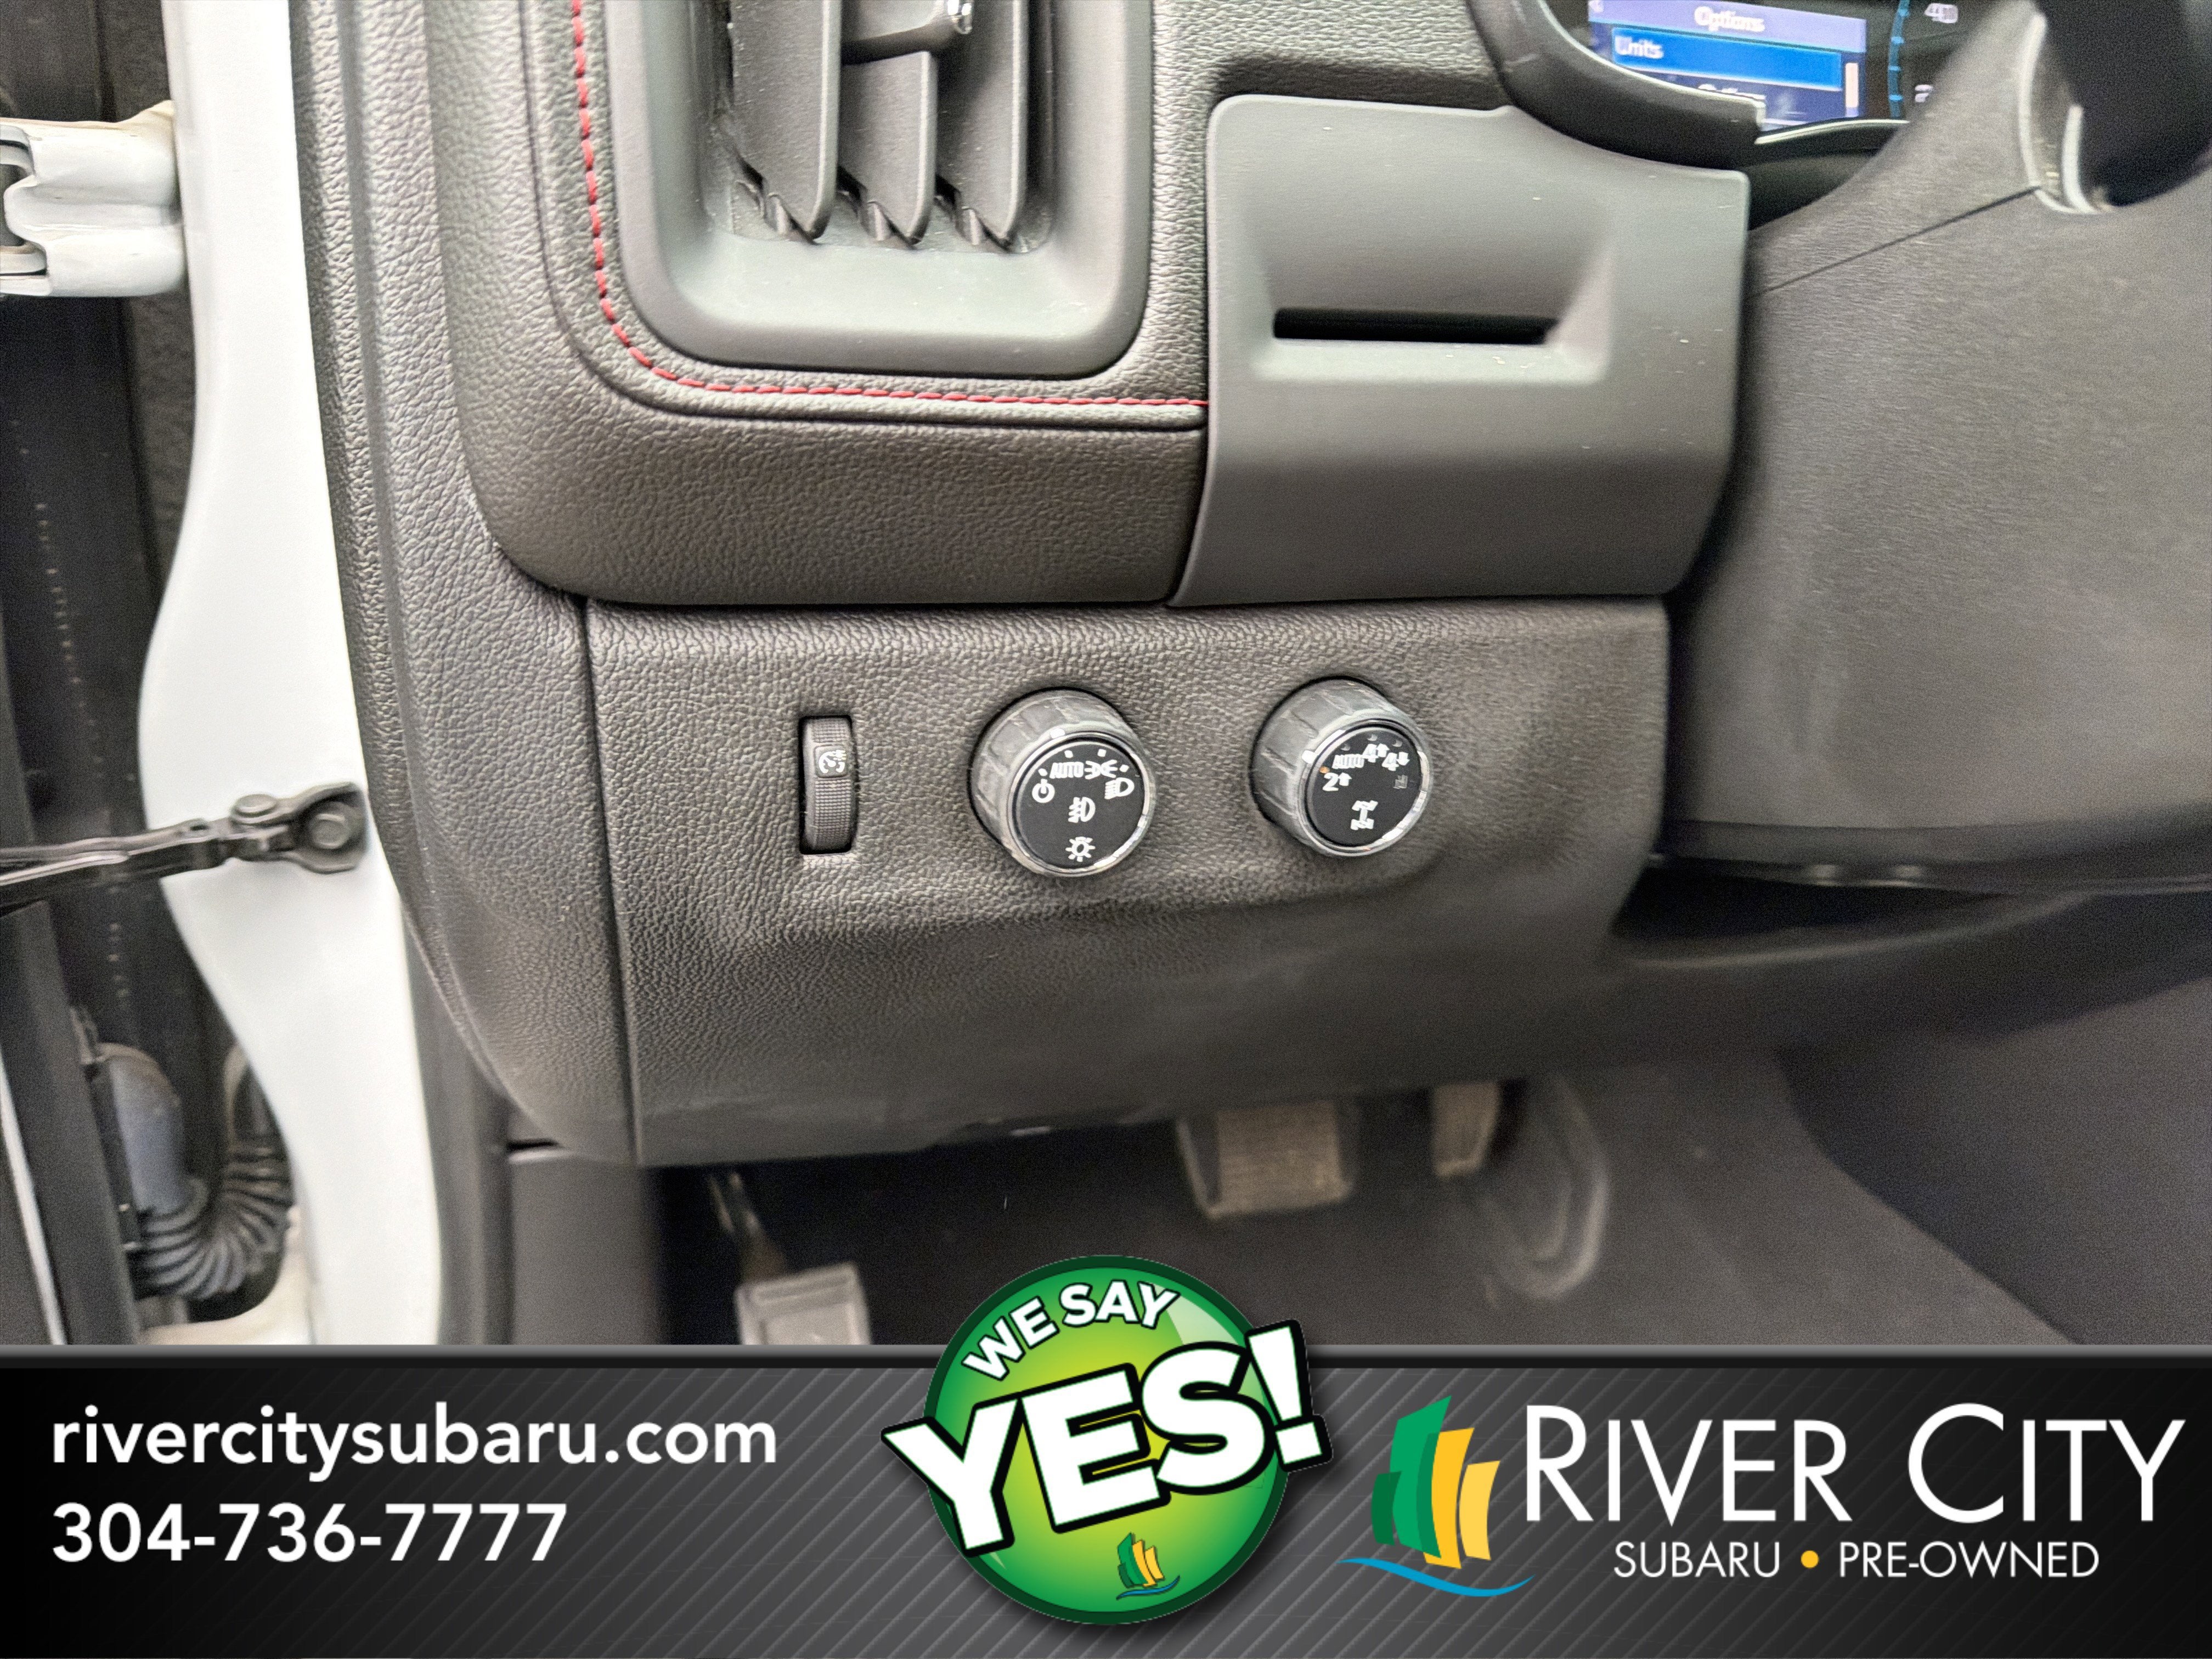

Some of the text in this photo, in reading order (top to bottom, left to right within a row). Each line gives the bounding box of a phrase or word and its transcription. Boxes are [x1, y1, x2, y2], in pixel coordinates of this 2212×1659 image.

[1694, 6, 1765, 32] Options
[1615, 36, 1663, 59] Units
[1049, 761, 1084, 779] AUTO
